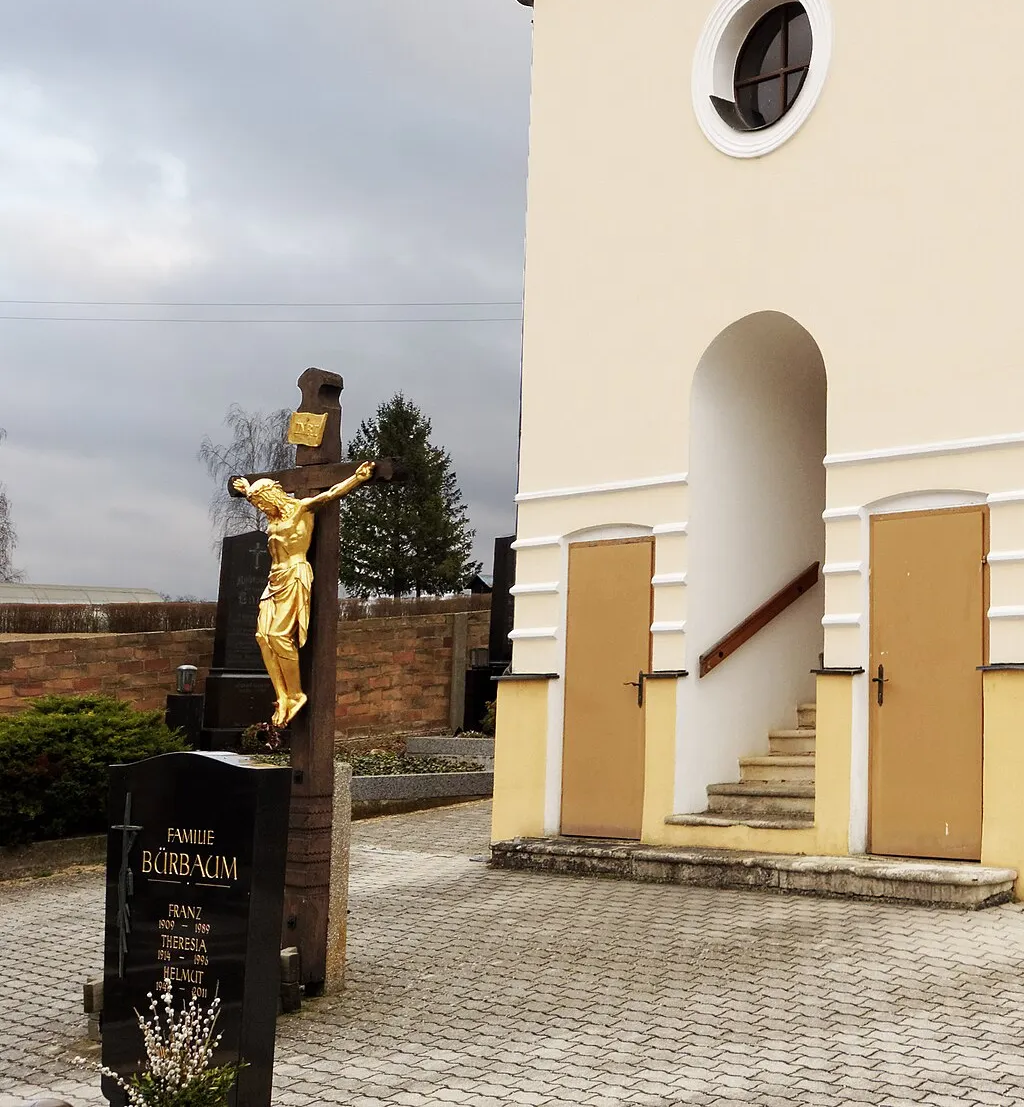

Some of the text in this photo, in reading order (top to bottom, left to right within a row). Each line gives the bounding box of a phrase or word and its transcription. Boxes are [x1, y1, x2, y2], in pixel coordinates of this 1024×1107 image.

[167, 827, 215, 845] FAMILIE
[142, 847, 238, 881] BÜRBAUM
[168, 903, 203, 920] FRANZ
[158, 919, 175, 931] 1909
[194, 922, 211, 935] 1989
[160, 934, 207, 953] THERESIA
[157, 949, 171, 962] 1914
[193, 954, 209, 966] 1996
[163, 965, 204, 984] HELMUT
[155, 981, 173, 992] 194
[191, 986, 208, 999] 2011
